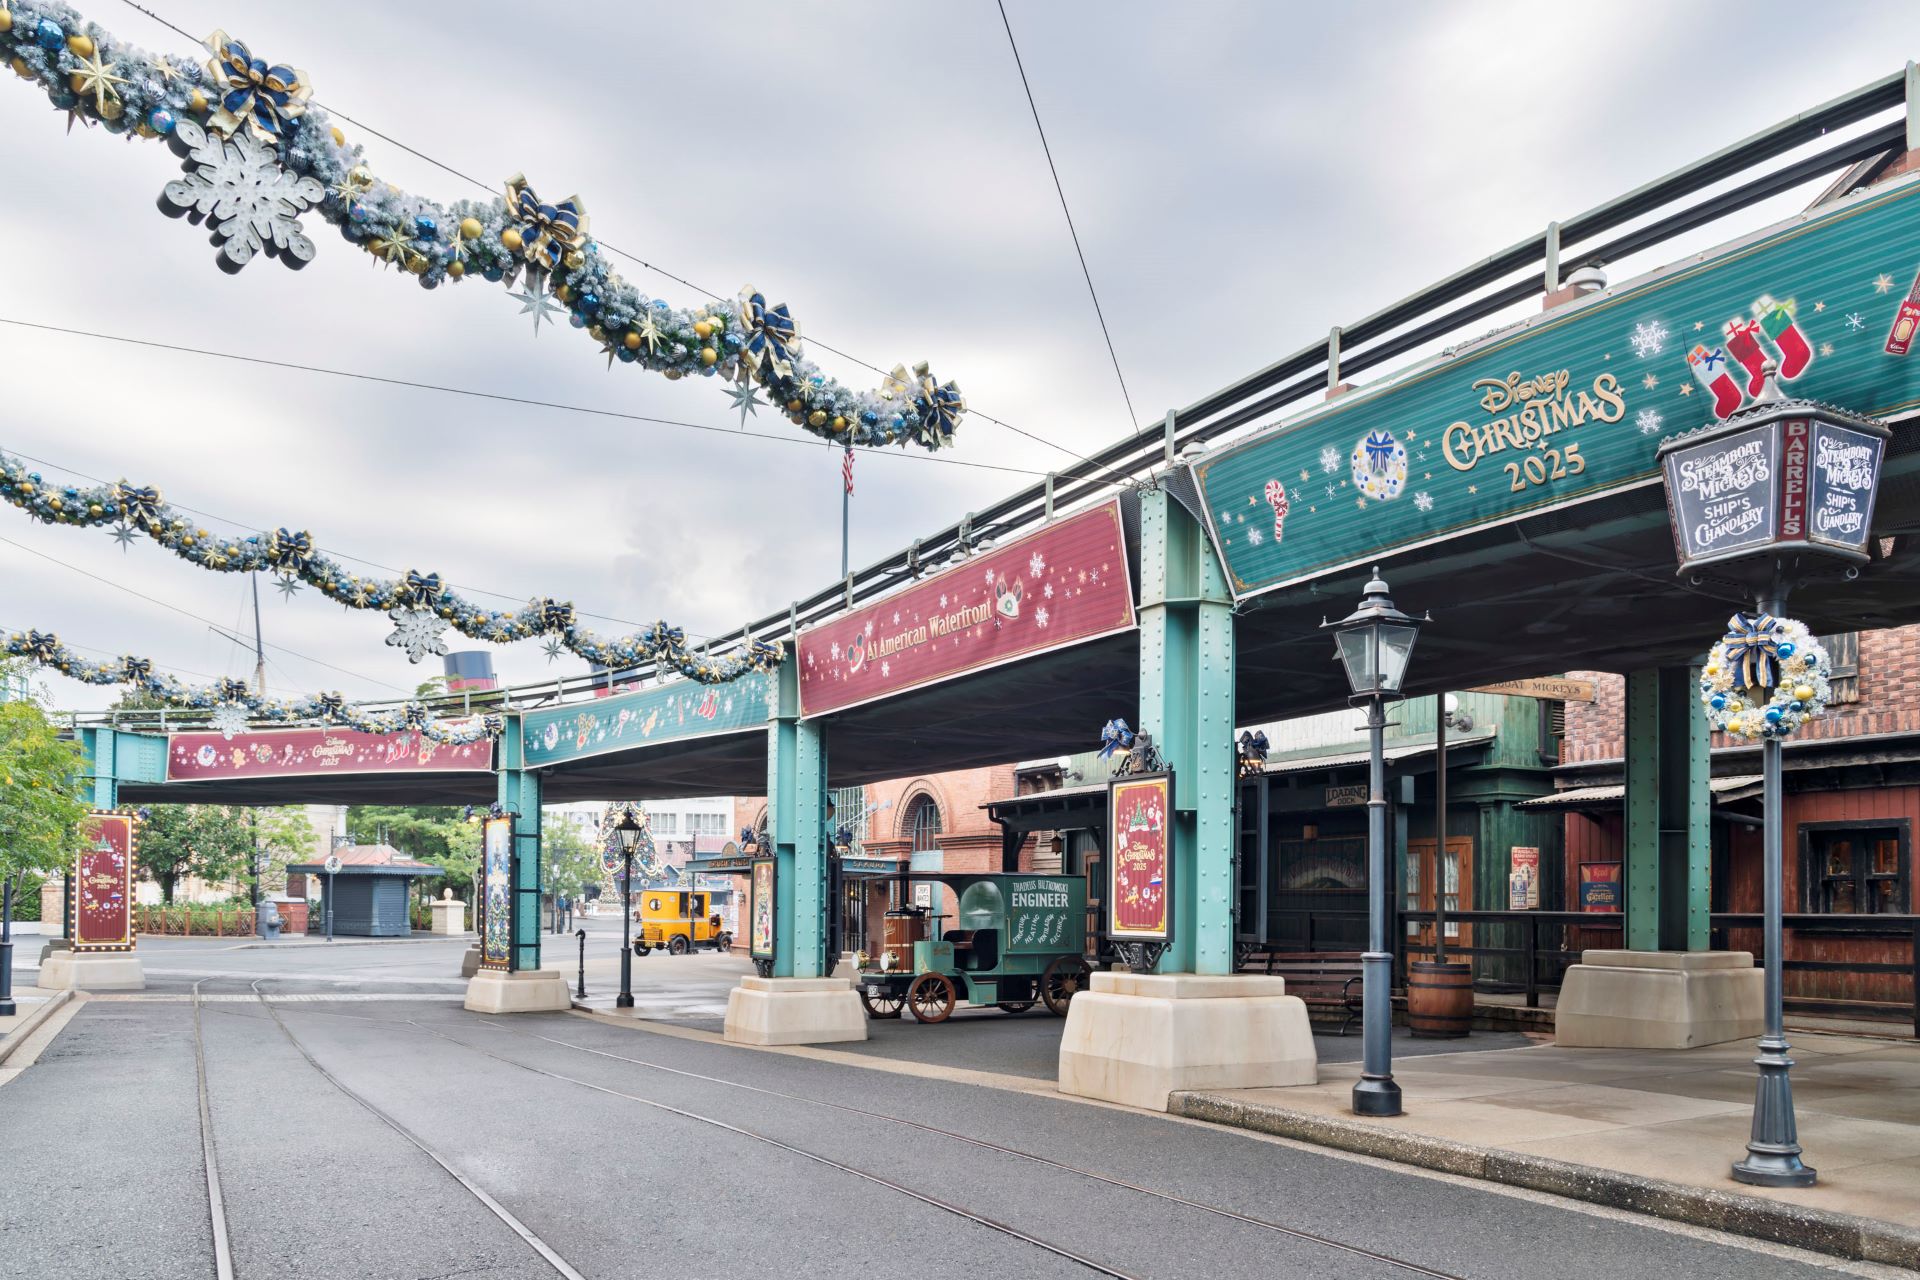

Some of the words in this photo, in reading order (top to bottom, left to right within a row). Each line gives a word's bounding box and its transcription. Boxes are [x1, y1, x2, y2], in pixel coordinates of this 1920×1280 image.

[1442, 374, 1625, 471] CHRISTMAS
[1504, 442, 1585, 492] 2025
[1680, 441, 1763, 492] STEAMBOAT
[1817, 436, 1872, 469] STEAMBOAT
[1784, 422, 1806, 535] BARRELLS
[1704, 497, 1751, 519] SHIP'S
[1826, 492, 1856, 511] SHIP'S
[1695, 507, 1764, 546] CHANDLERY
[1817, 507, 1863, 533] CHANDLERY
[867, 640, 877, 661] At
[879, 625, 927, 658] American
[928, 598, 992, 638] Waterfront
[1328, 786, 1366, 800] LOADING
[1012, 893, 1069, 907] ENGINEER
[1012, 913, 1030, 945] STRUCTURAL
[1024, 914, 1040, 944] HEATING
[1049, 914, 1068, 945] ELECTRICAL
